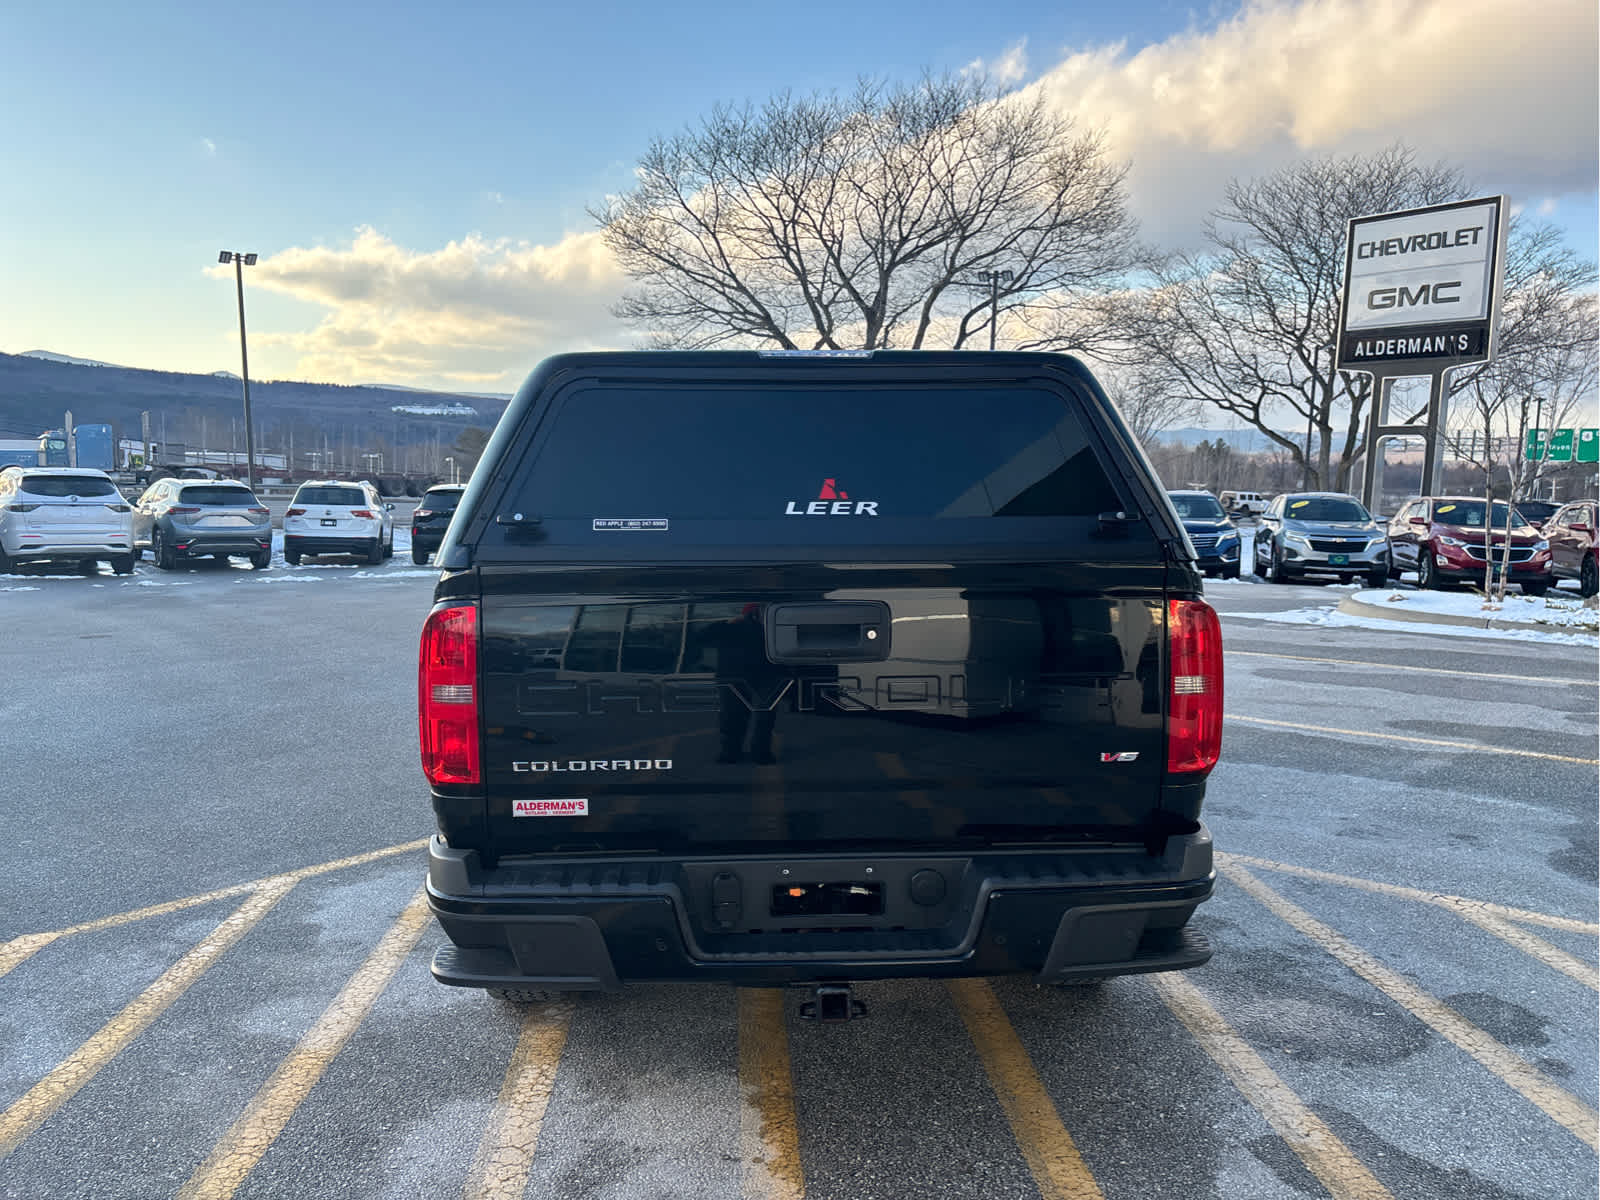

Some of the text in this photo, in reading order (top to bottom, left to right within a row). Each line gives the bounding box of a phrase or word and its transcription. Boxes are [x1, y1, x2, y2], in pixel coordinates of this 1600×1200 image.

[1357, 226, 1483, 260] CHEVROLET
[1367, 281, 1461, 310] GMC
[1354, 333, 1469, 357] ALDERMAN'S
[785, 501, 879, 515] LEER
[512, 759, 673, 772] COLORADO
[516, 801, 585, 811] ALDERMAN'S
